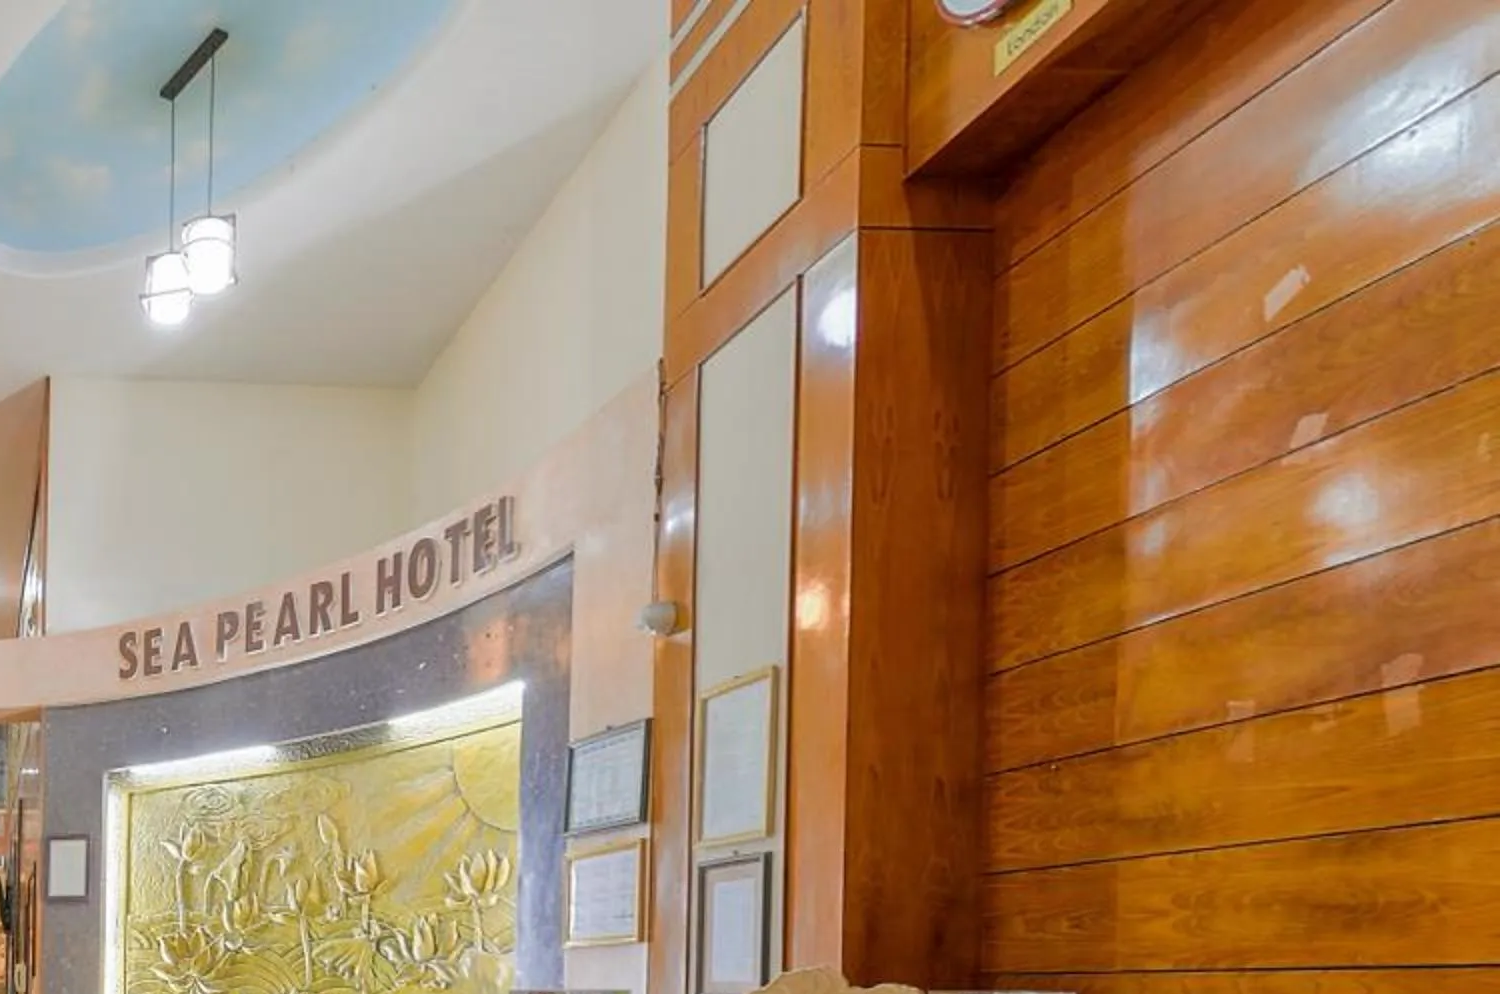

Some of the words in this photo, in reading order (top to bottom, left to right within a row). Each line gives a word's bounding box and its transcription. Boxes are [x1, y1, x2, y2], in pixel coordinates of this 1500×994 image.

[118, 620, 198, 679] SEA
[215, 571, 359, 660] PEARL
[375, 495, 518, 614] HOTEL
